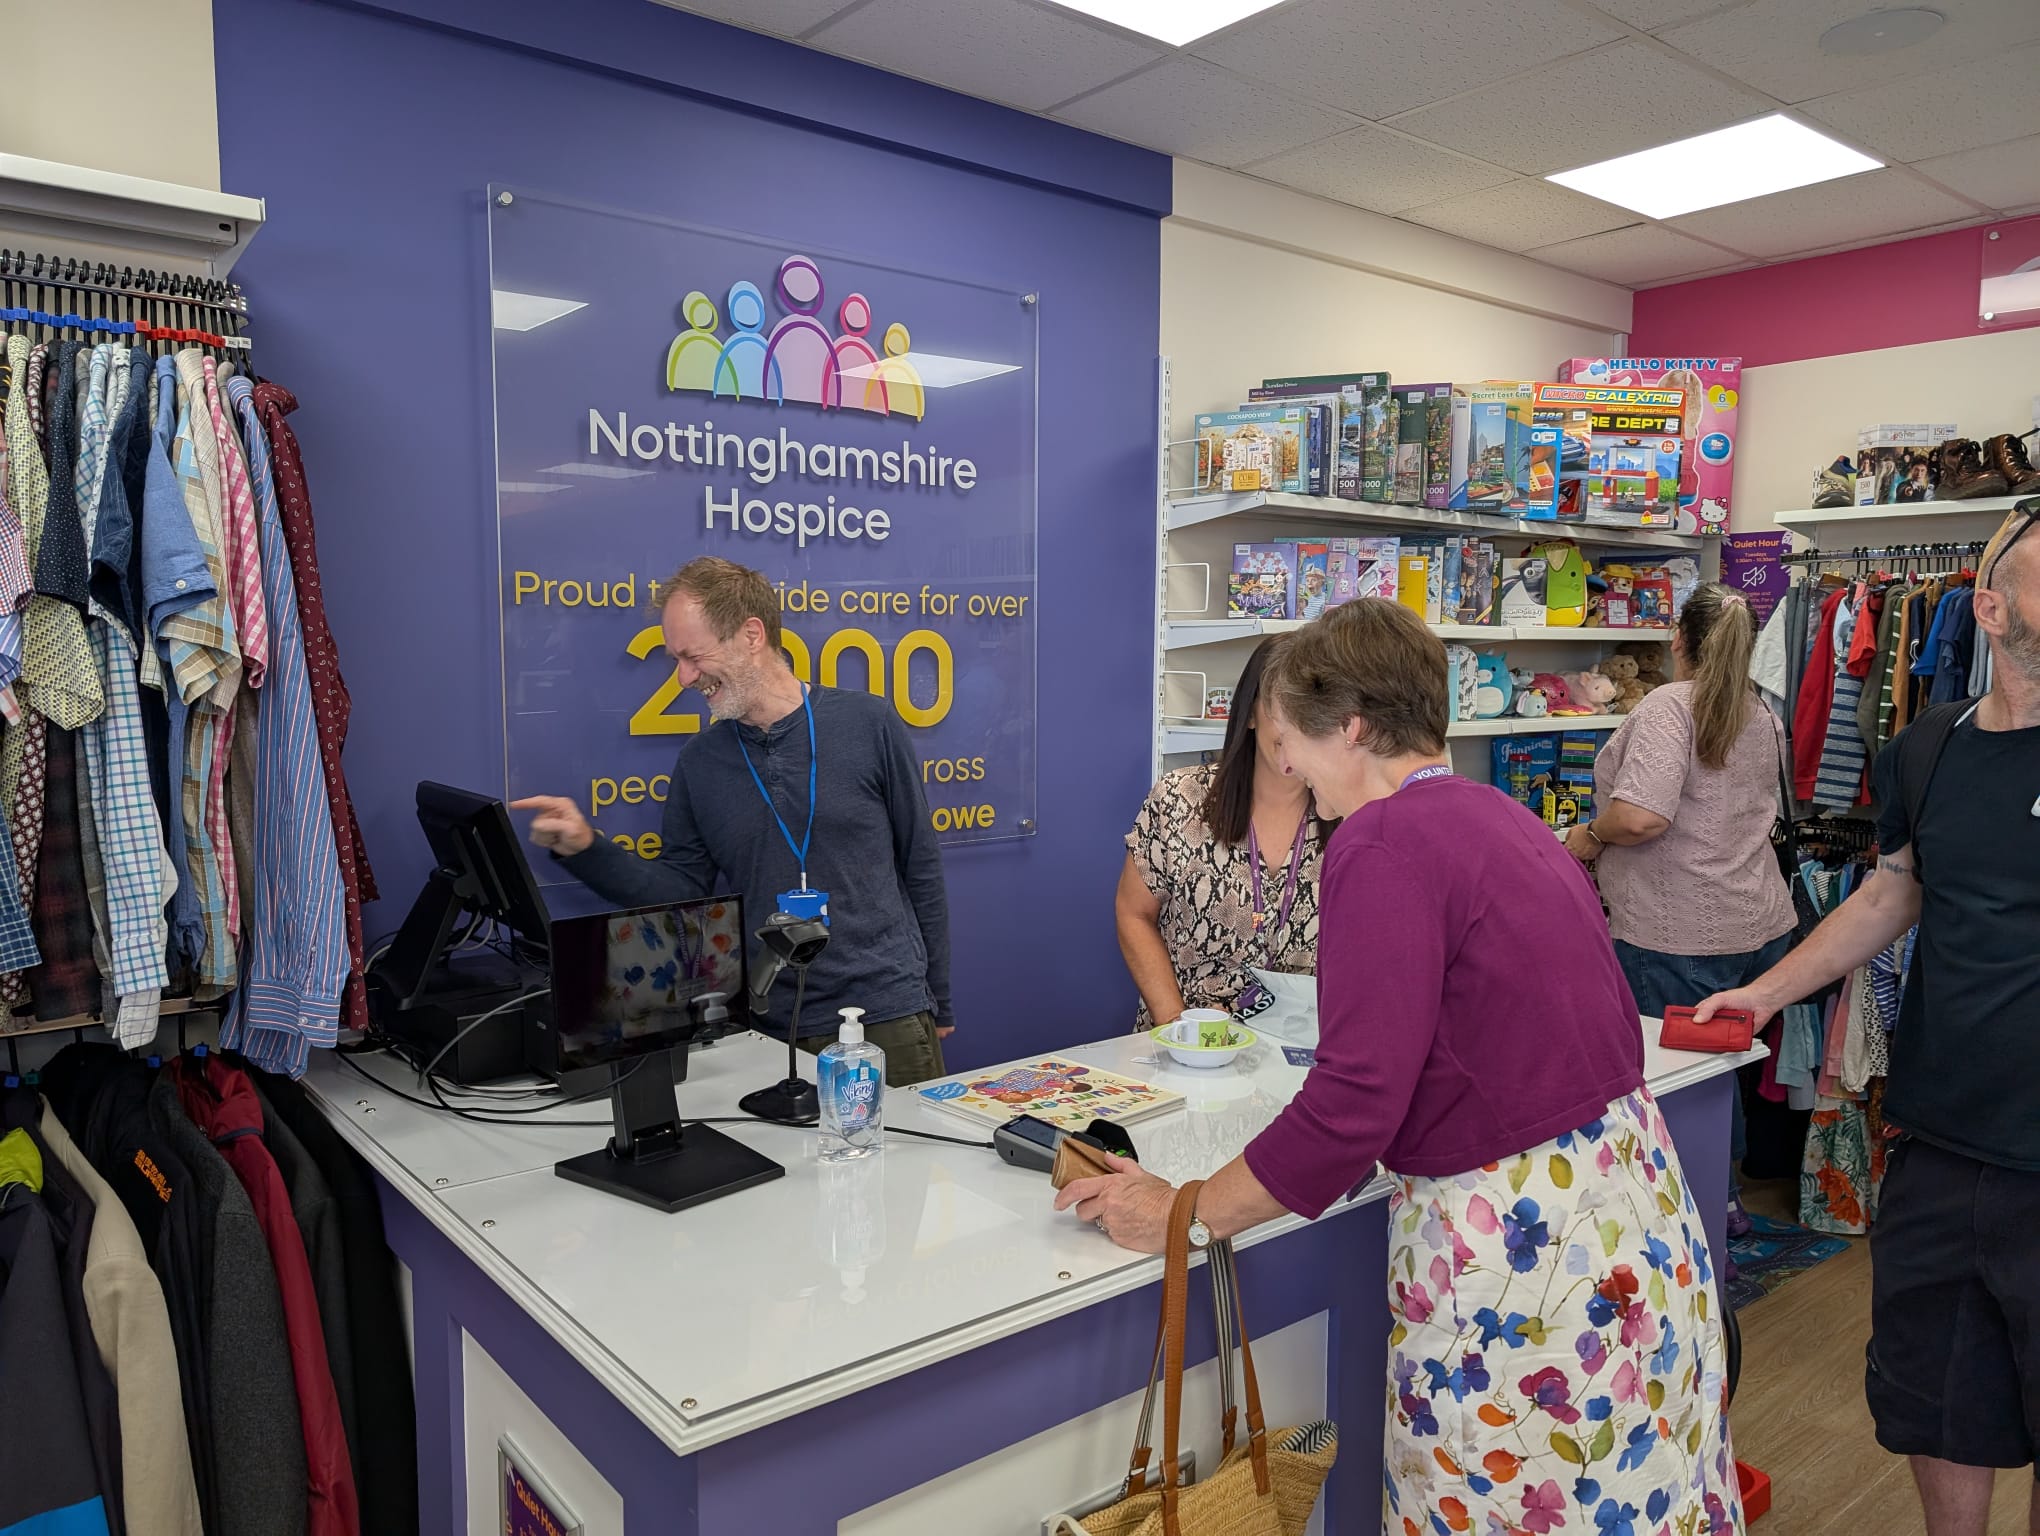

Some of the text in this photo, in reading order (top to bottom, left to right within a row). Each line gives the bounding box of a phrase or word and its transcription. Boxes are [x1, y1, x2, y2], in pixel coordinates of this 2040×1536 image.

[1609, 358, 1718, 370] HELLO KITTY
[1471, 392, 1496, 400] Secret
[1497, 391, 1513, 399] Lost
[1543, 389, 1586, 400] MICRO
[1717, 392, 1726, 403] 6
[1257, 411, 1271, 419] VIEW
[588, 408, 978, 491] Nottinghamshire
[1338, 479, 1356, 488] 500
[704, 485, 891, 548] Hospice
[1733, 539, 1780, 549] Quiet Hour
[514, 570, 636, 608] Proud
[776, 580, 830, 613] ide
[839, 588, 912, 615] care
[919, 585, 960, 617] for
[968, 591, 1029, 618] over
[841, 1077, 876, 1102] Viking
[1007, 1085, 1126, 1114] Numbers
[1110, 1093, 1157, 1110] First
[1069, 1100, 1100, 1112] and
[516, 1479, 541, 1521] Quiet
